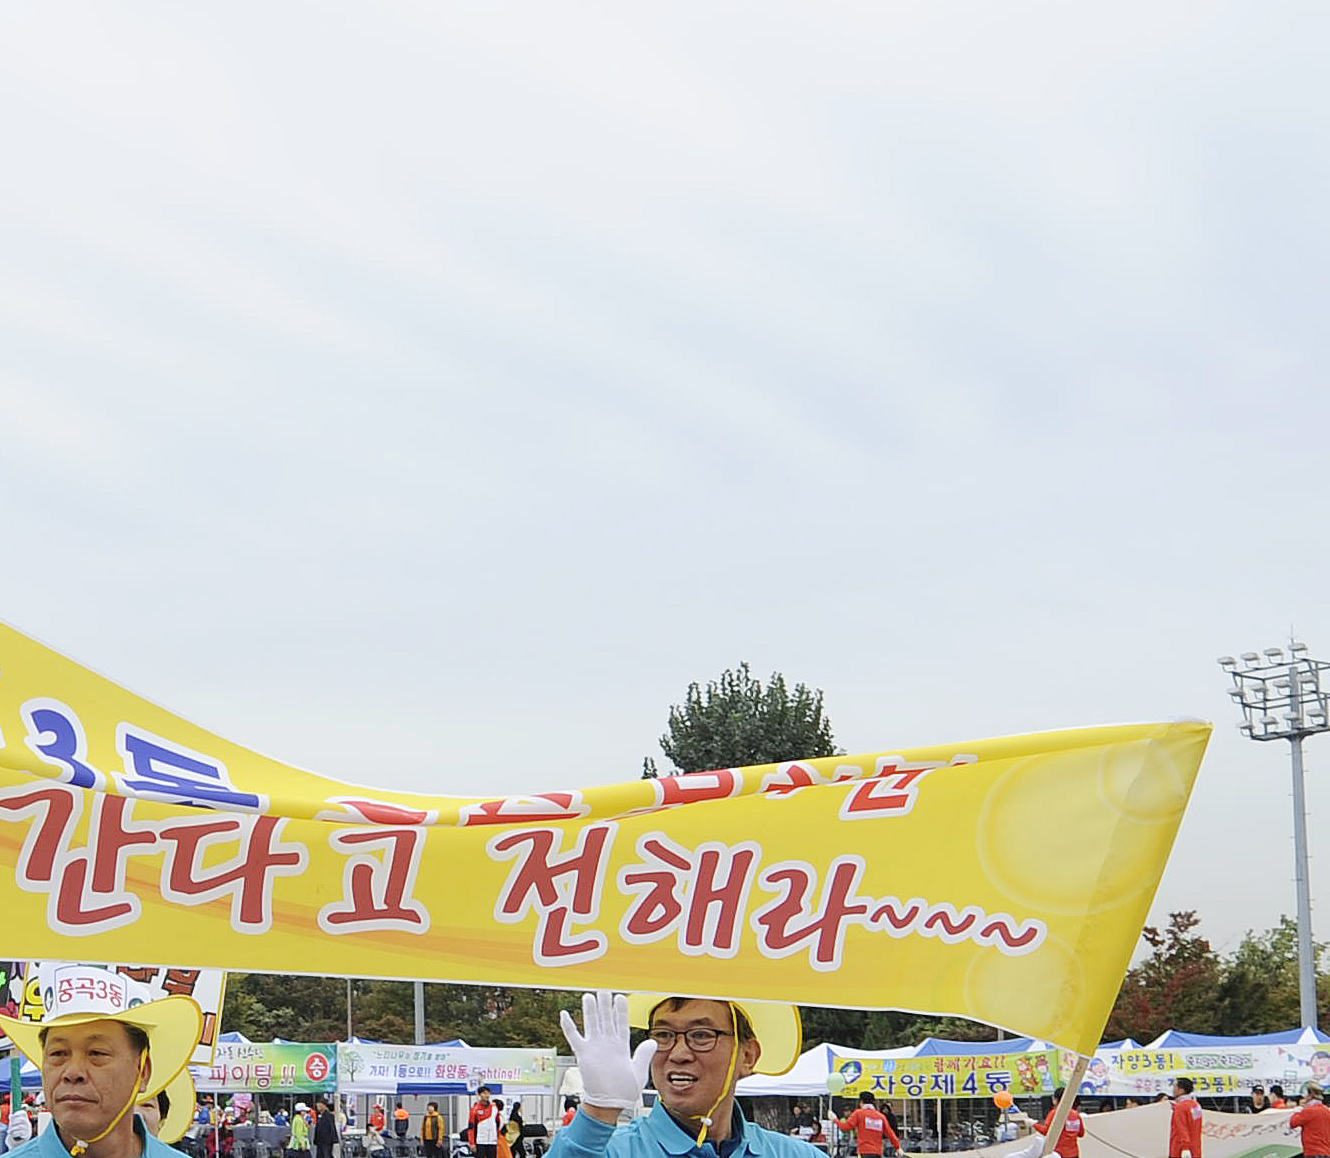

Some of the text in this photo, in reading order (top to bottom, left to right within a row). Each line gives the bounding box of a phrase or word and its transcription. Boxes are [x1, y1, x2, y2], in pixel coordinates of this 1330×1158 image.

[58, 977, 122, 1008] 중곡3동
[308, 1057, 326, 1078] 승
[369, 1065, 390, 1077] 가자!
[1111, 1053, 1175, 1071] 자양3동!
[870, 1071, 1012, 1097] 자양제4동
